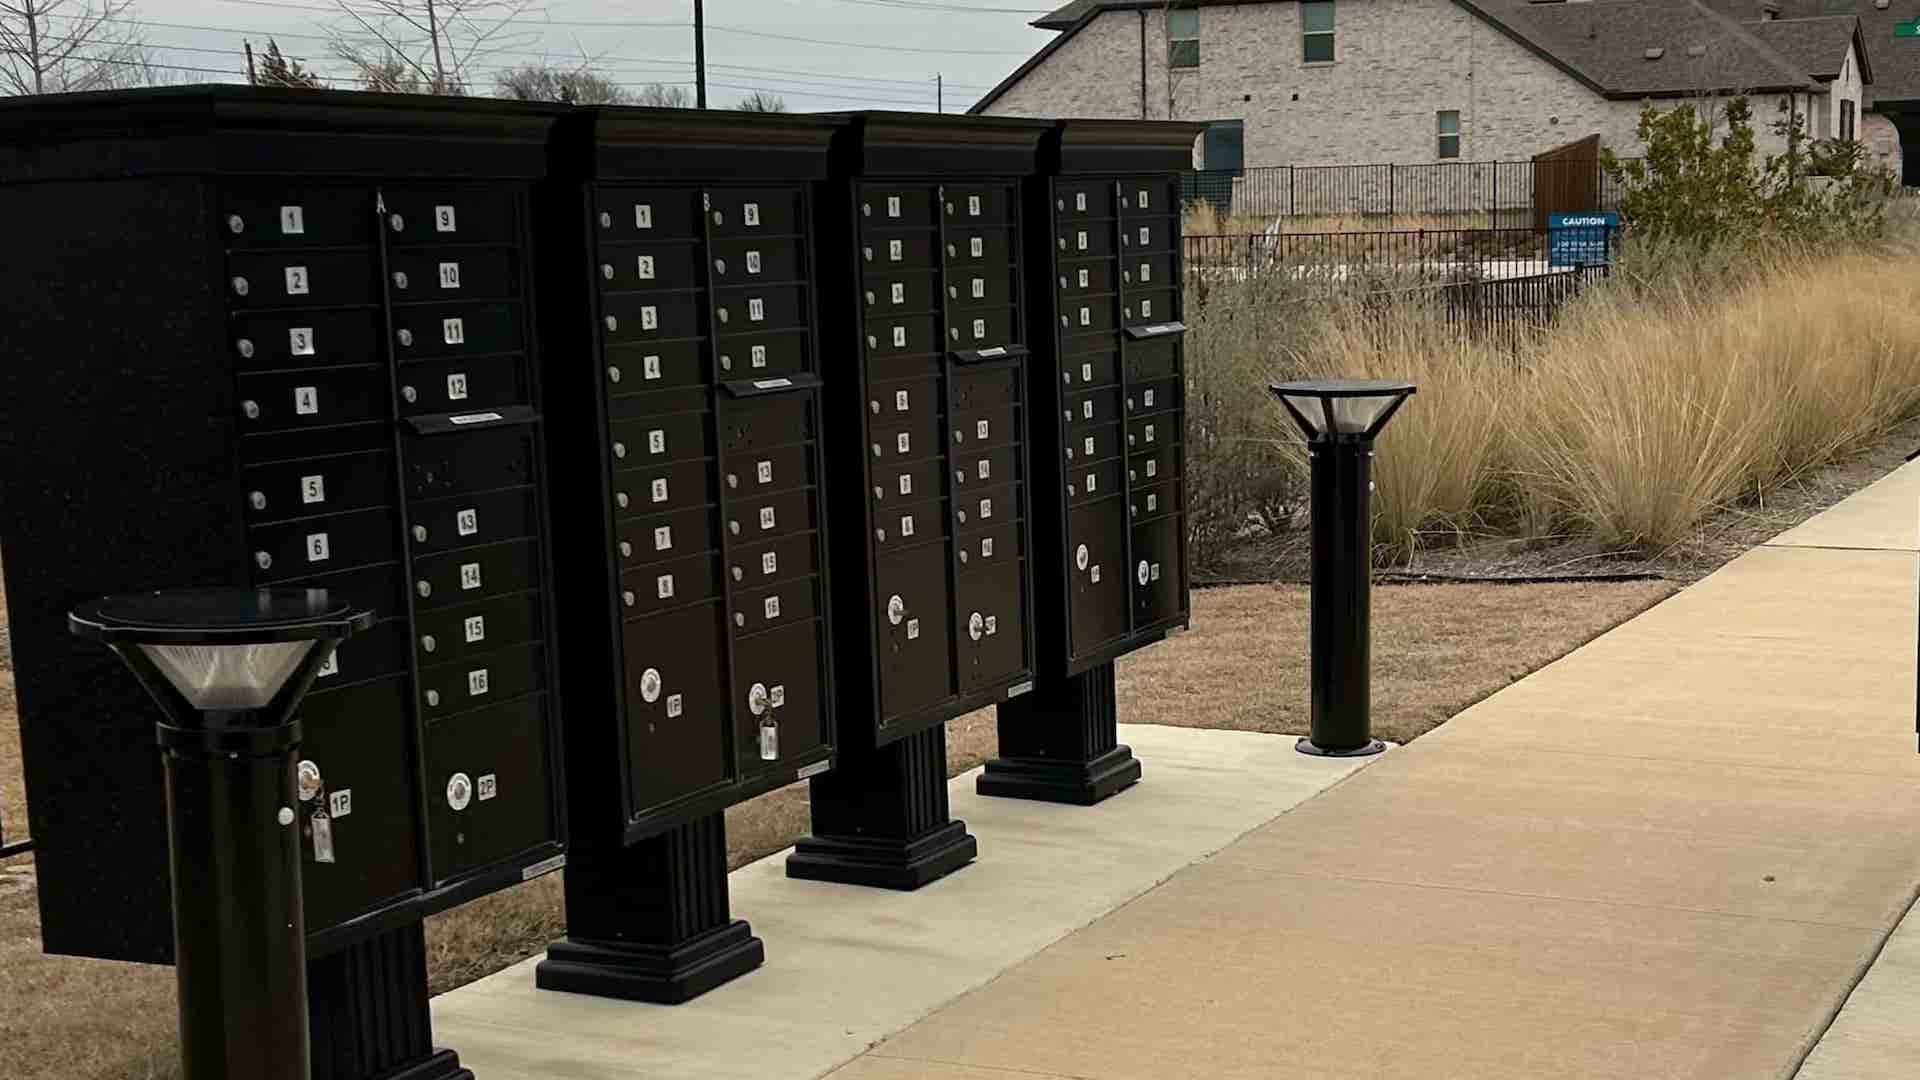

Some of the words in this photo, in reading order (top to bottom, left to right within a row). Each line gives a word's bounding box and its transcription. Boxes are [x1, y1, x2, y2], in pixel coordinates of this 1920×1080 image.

[1562, 217, 1605, 225] CAUTION
[442, 266, 457, 284] 10
[751, 302, 761, 317] 11
[447, 322, 460, 340] 11
[450, 378, 465, 395] 12
[460, 514, 475, 530] 13
[464, 567, 478, 584] 14
[468, 620, 482, 636] 15
[472, 674, 486, 690] 16
[479, 778, 494, 796] 2P
[332, 794, 349, 812] 1P
